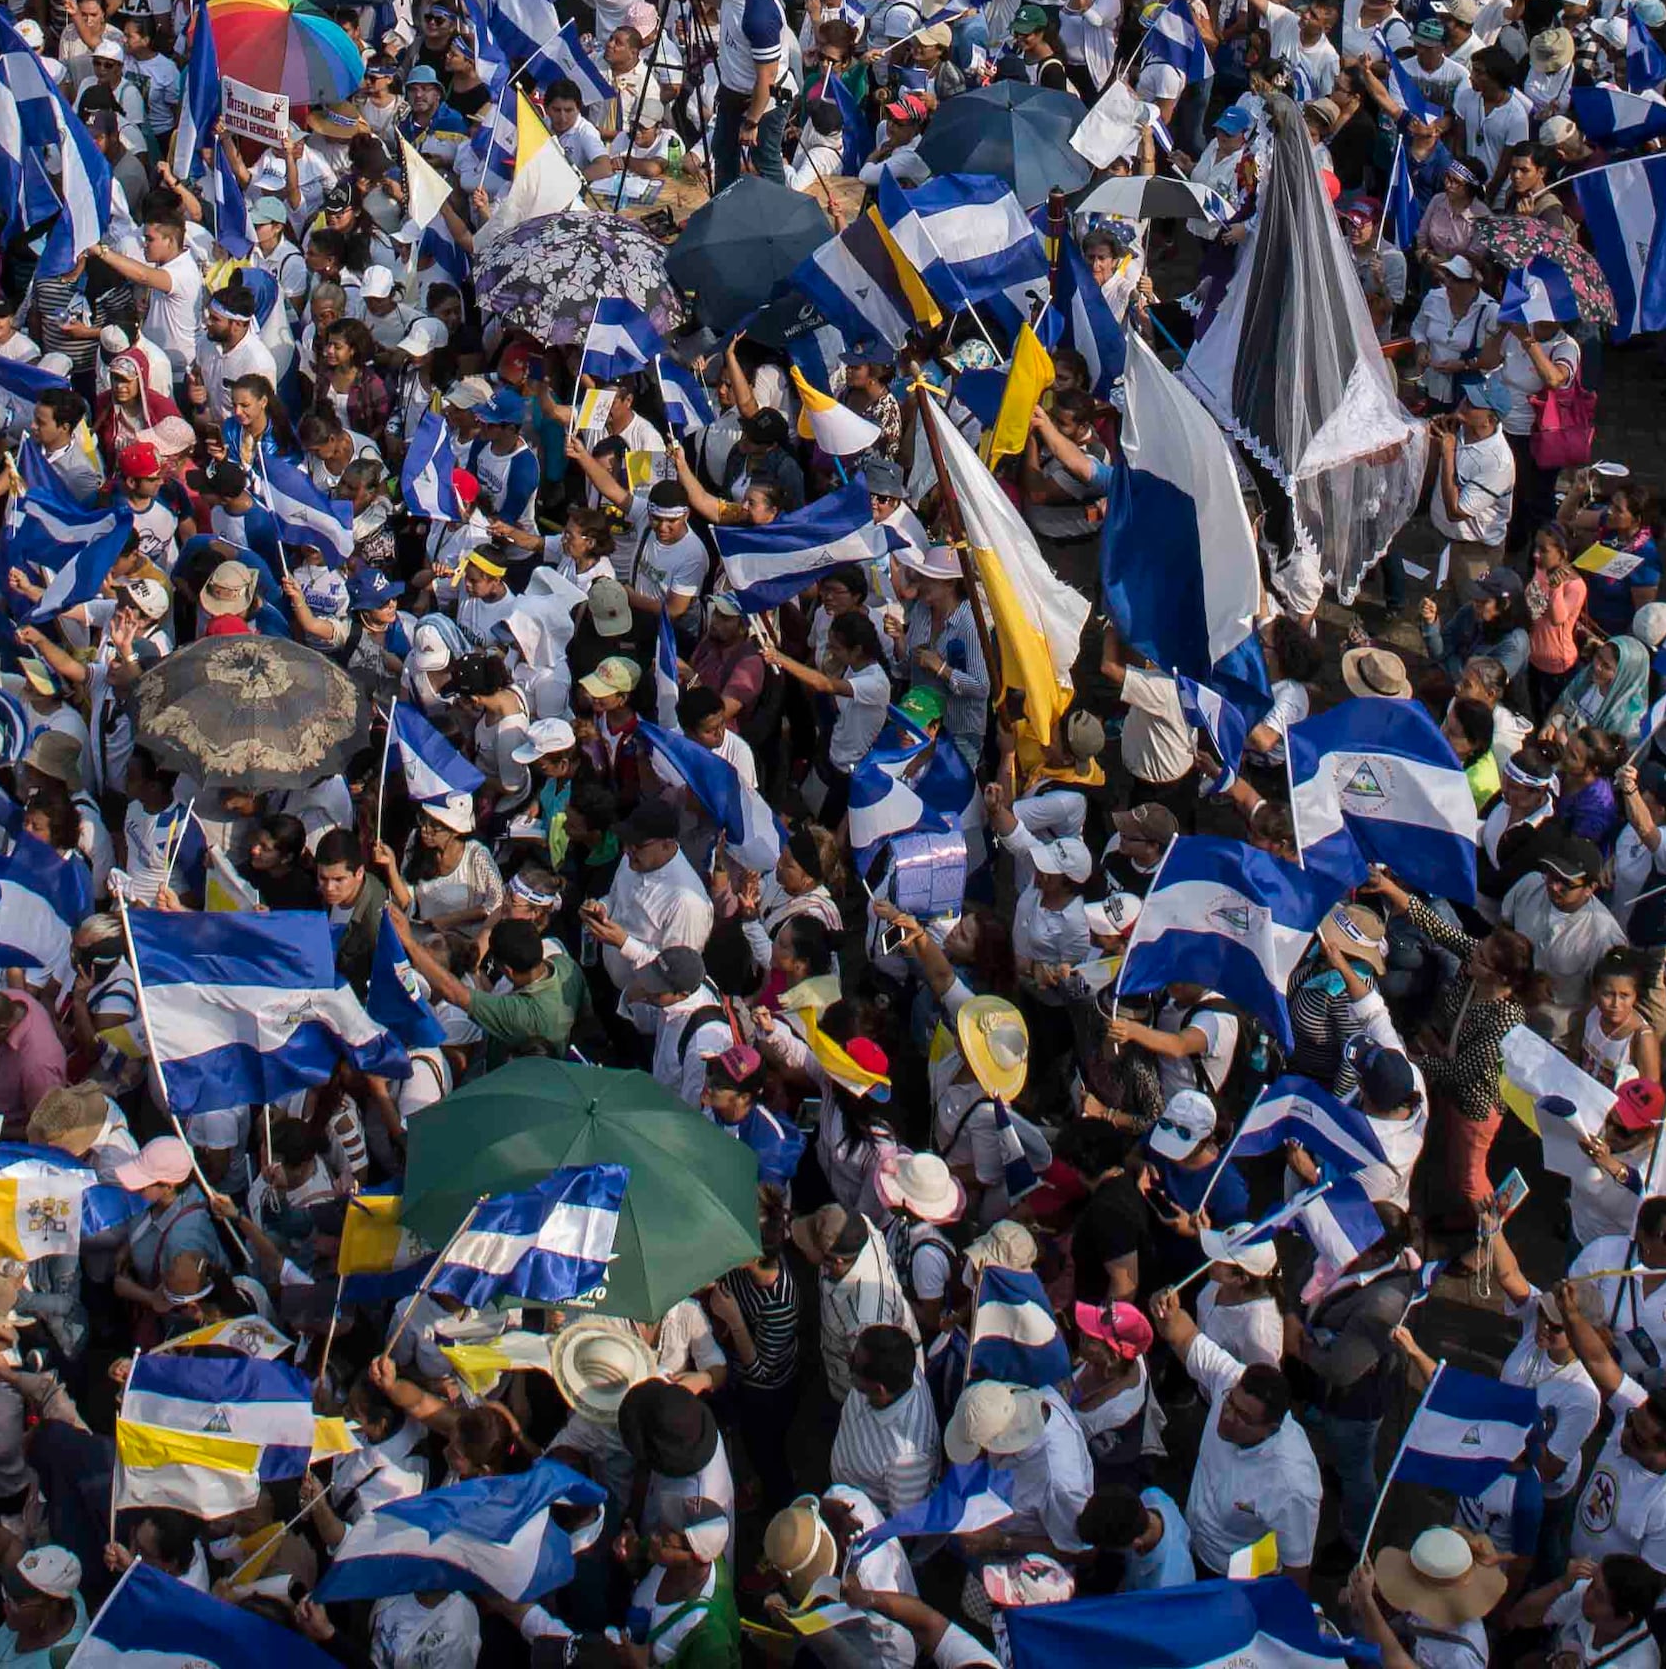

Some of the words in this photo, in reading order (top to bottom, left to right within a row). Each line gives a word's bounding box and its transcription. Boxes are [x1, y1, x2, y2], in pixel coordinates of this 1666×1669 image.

[227, 98, 248, 115] ORTEGA
[250, 106, 275, 123] ASESINO
[225, 114, 248, 131] ORTEGA
